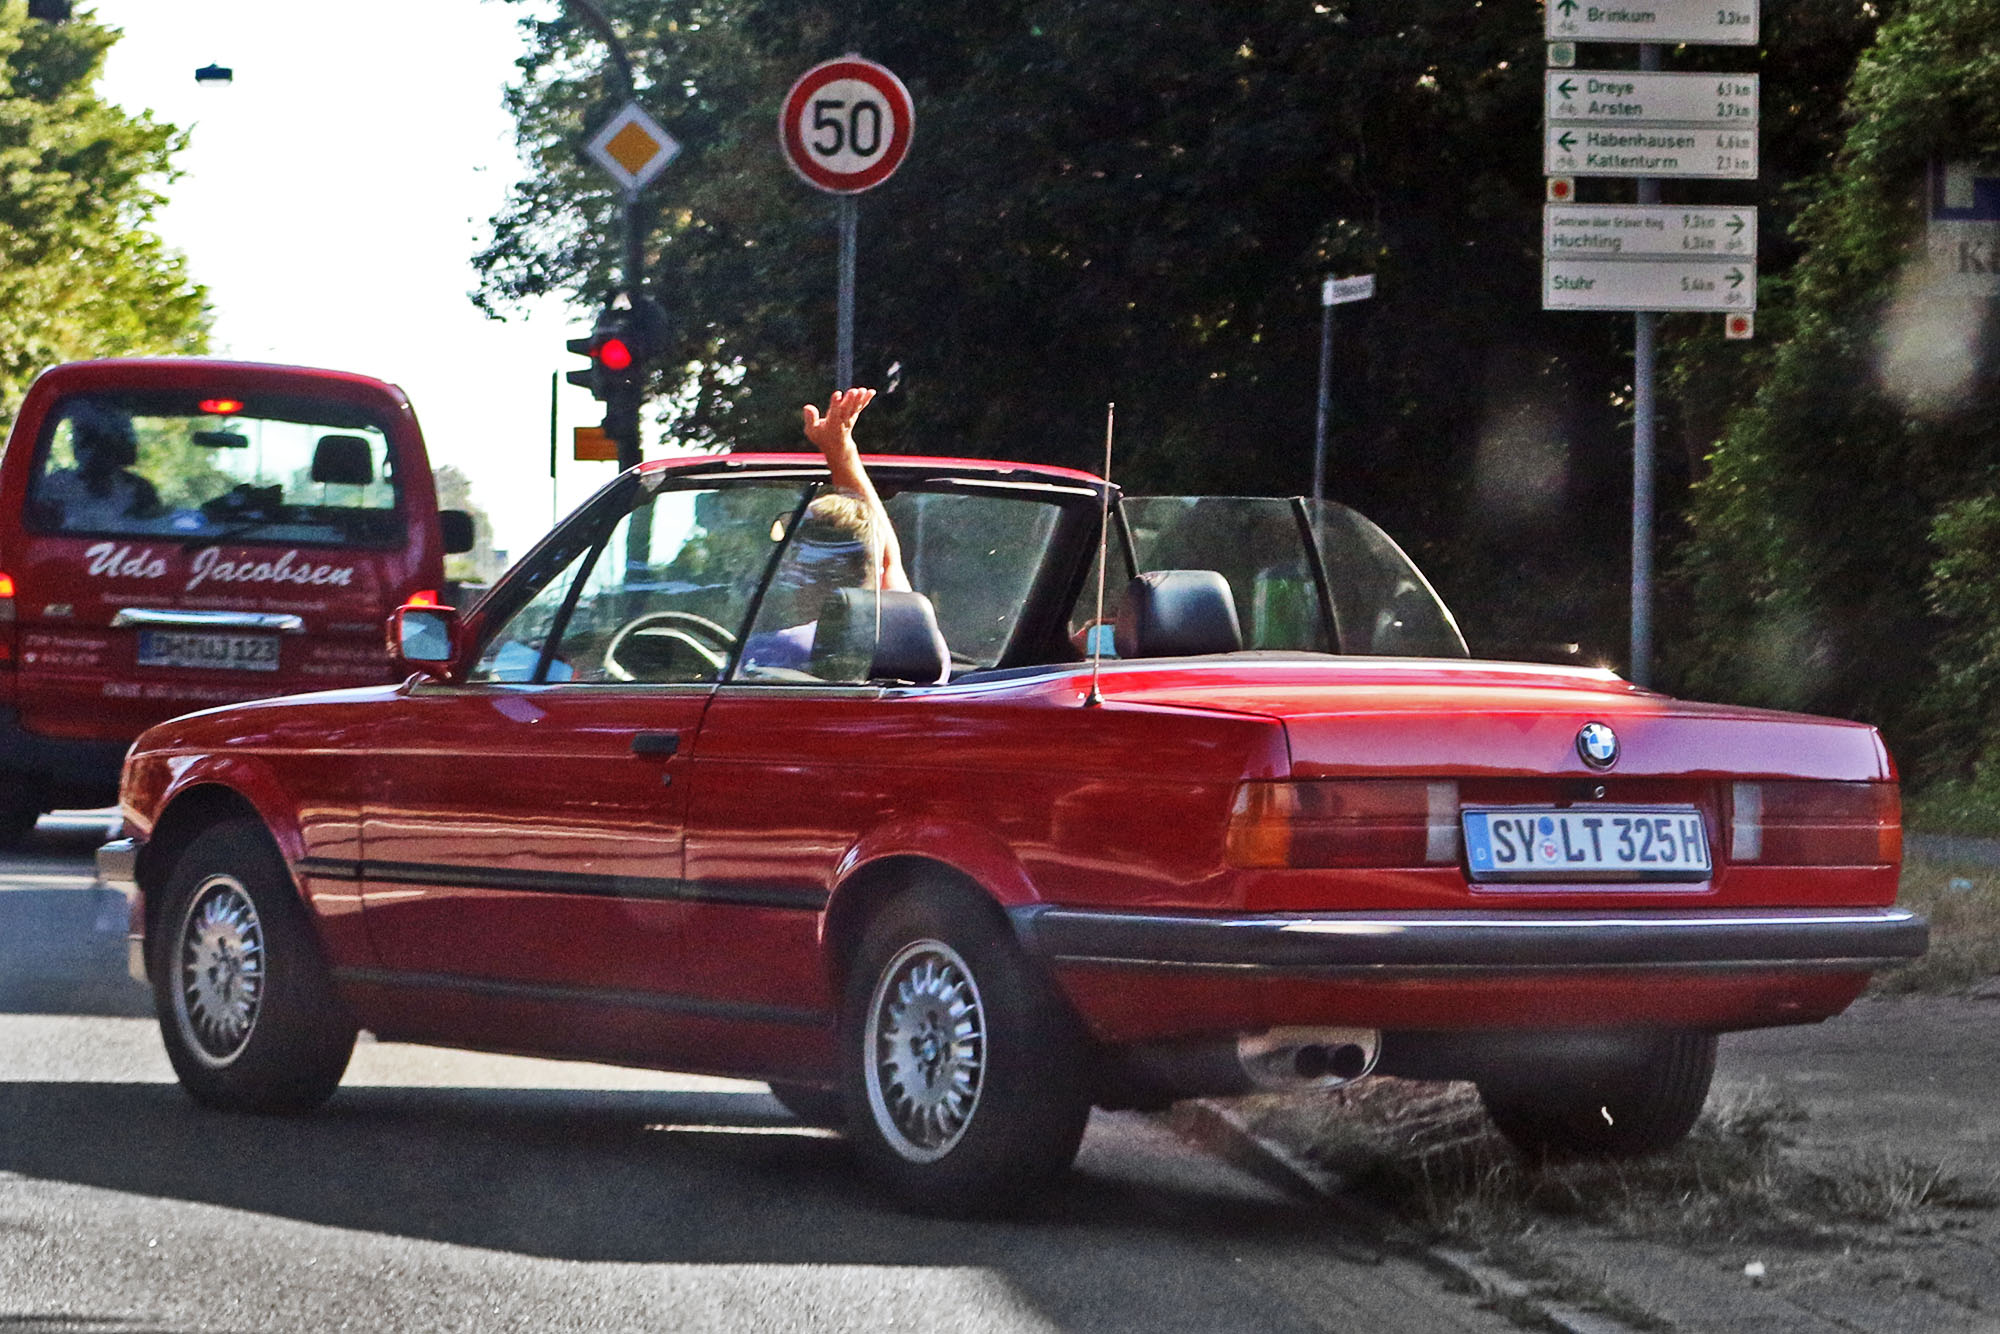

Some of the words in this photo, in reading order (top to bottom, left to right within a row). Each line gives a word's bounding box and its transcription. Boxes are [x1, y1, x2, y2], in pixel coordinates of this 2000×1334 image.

[1587, 7, 1656, 23] Brinkum
[1587, 78, 1635, 97] Dreye
[1587, 100, 1643, 115] Arsten
[812, 99, 882, 157] 50
[1587, 132, 1695, 148] Habenhausen
[1587, 154, 1678, 169] Kattenturm
[1553, 234, 1622, 251] Huchting
[1553, 275, 1596, 290] Stuhr
[84, 540, 167, 579] Udo
[185, 546, 355, 590] Jacobsen
[1492, 818, 1536, 863] SY
[1560, 818, 1602, 862] LT
[1612, 819, 1703, 863] 325H
